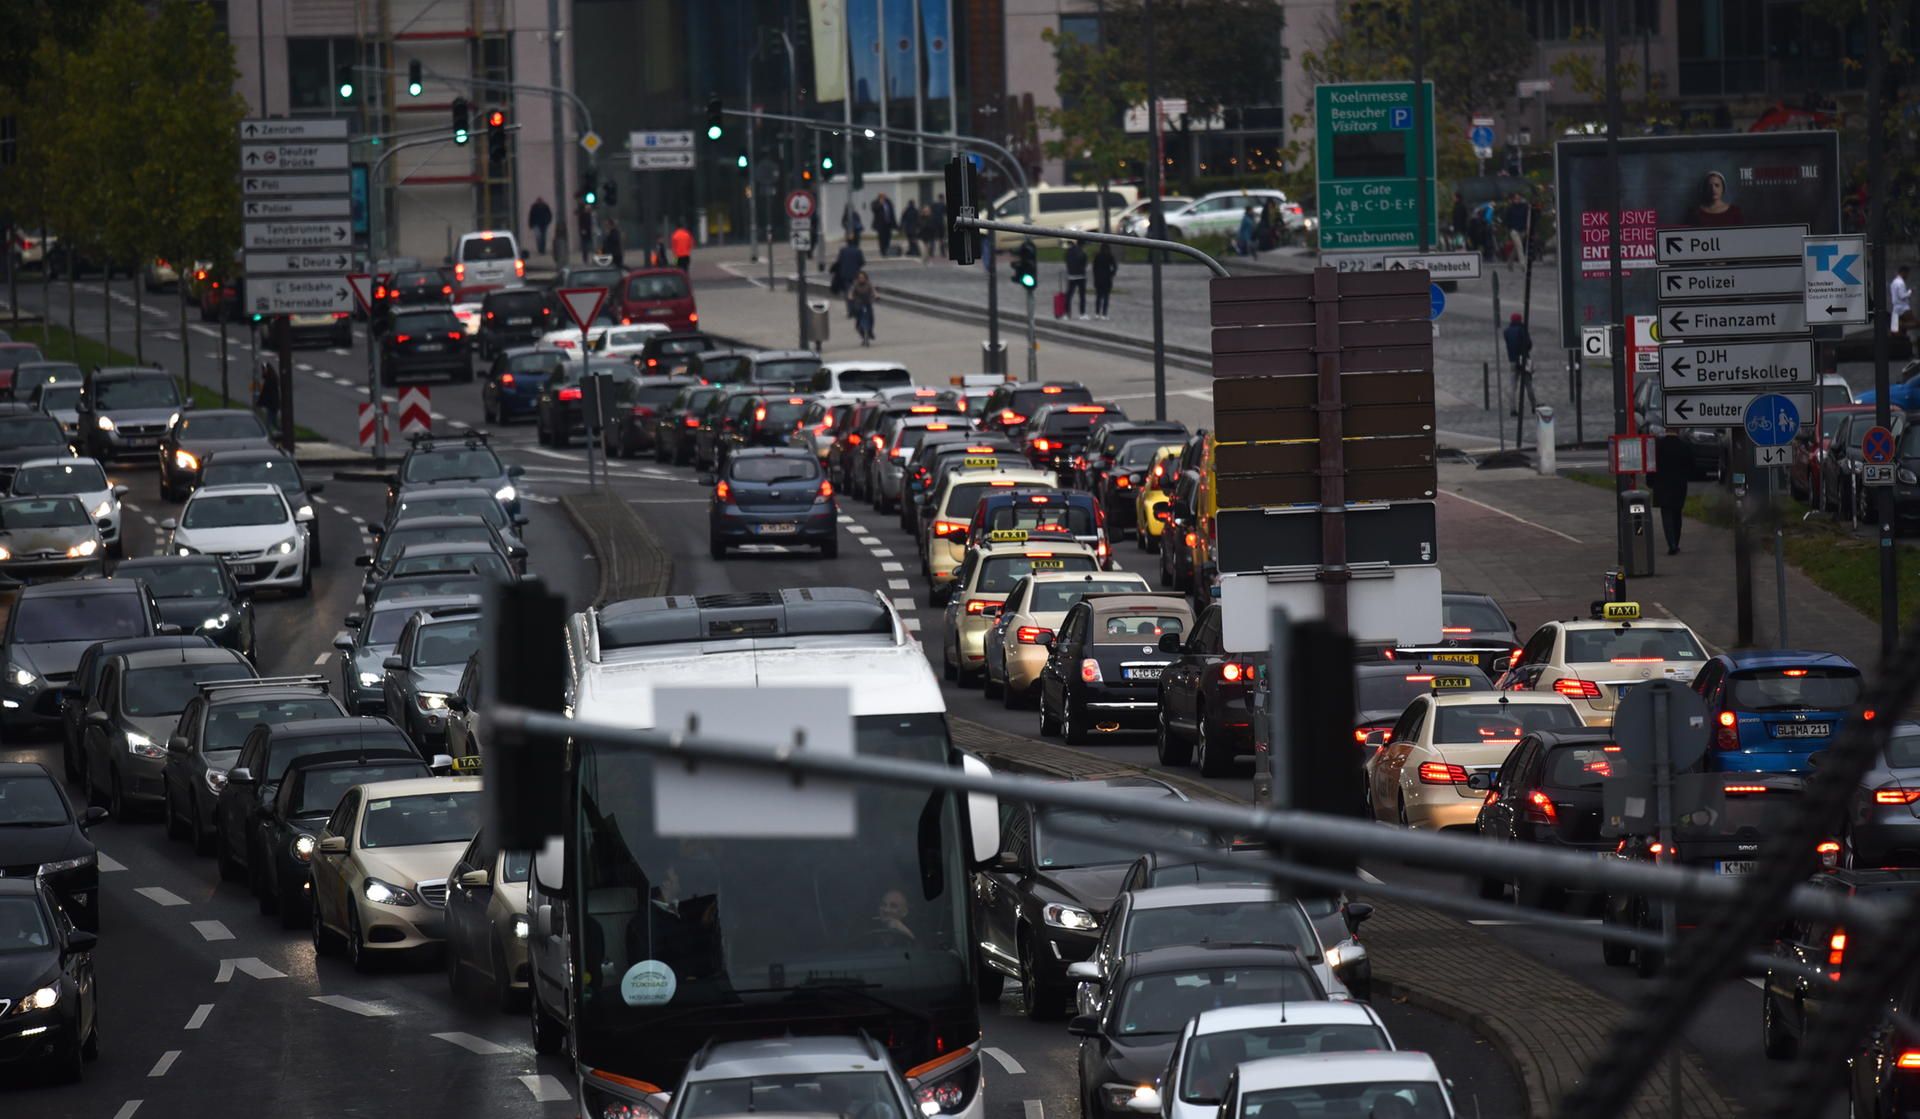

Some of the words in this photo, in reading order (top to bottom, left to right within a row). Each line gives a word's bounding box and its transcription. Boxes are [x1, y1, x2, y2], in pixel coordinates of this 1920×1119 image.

[1330, 90, 1408, 103] Koelnmesse
[1331, 106, 1387, 119] Besucher
[1394, 109, 1408, 127] P
[262, 125, 304, 134] Zentrum
[1331, 120, 1378, 132] Visitors
[279, 147, 318, 156] Deutzer
[279, 158, 315, 168] Brücke
[1739, 167, 1752, 180] THE
[1800, 164, 1819, 178] TALE
[261, 180, 280, 190] Poll
[1333, 184, 1354, 196] Tor
[1362, 183, 1392, 195] Gate
[267, 224, 331, 234] Tanzbrunnen
[1335, 230, 1415, 243] Tanzbrunnen
[1583, 243, 1656, 259] ENTRTAIN
[1690, 237, 1721, 252] Poll
[303, 257, 331, 267] Deutz
[1689, 275, 1735, 290] Polizei
[1695, 313, 1776, 328] Finanzamt
[1586, 336, 1601, 354] C
[1696, 350, 1728, 364] DJH
[1697, 365, 1798, 382] Berufskolleg
[1699, 402, 1743, 417] Deutzer
[1611, 606, 1636, 616] TAXI
[1439, 679, 1465, 687] TAXI
[1811, 725, 1828, 734] 211
